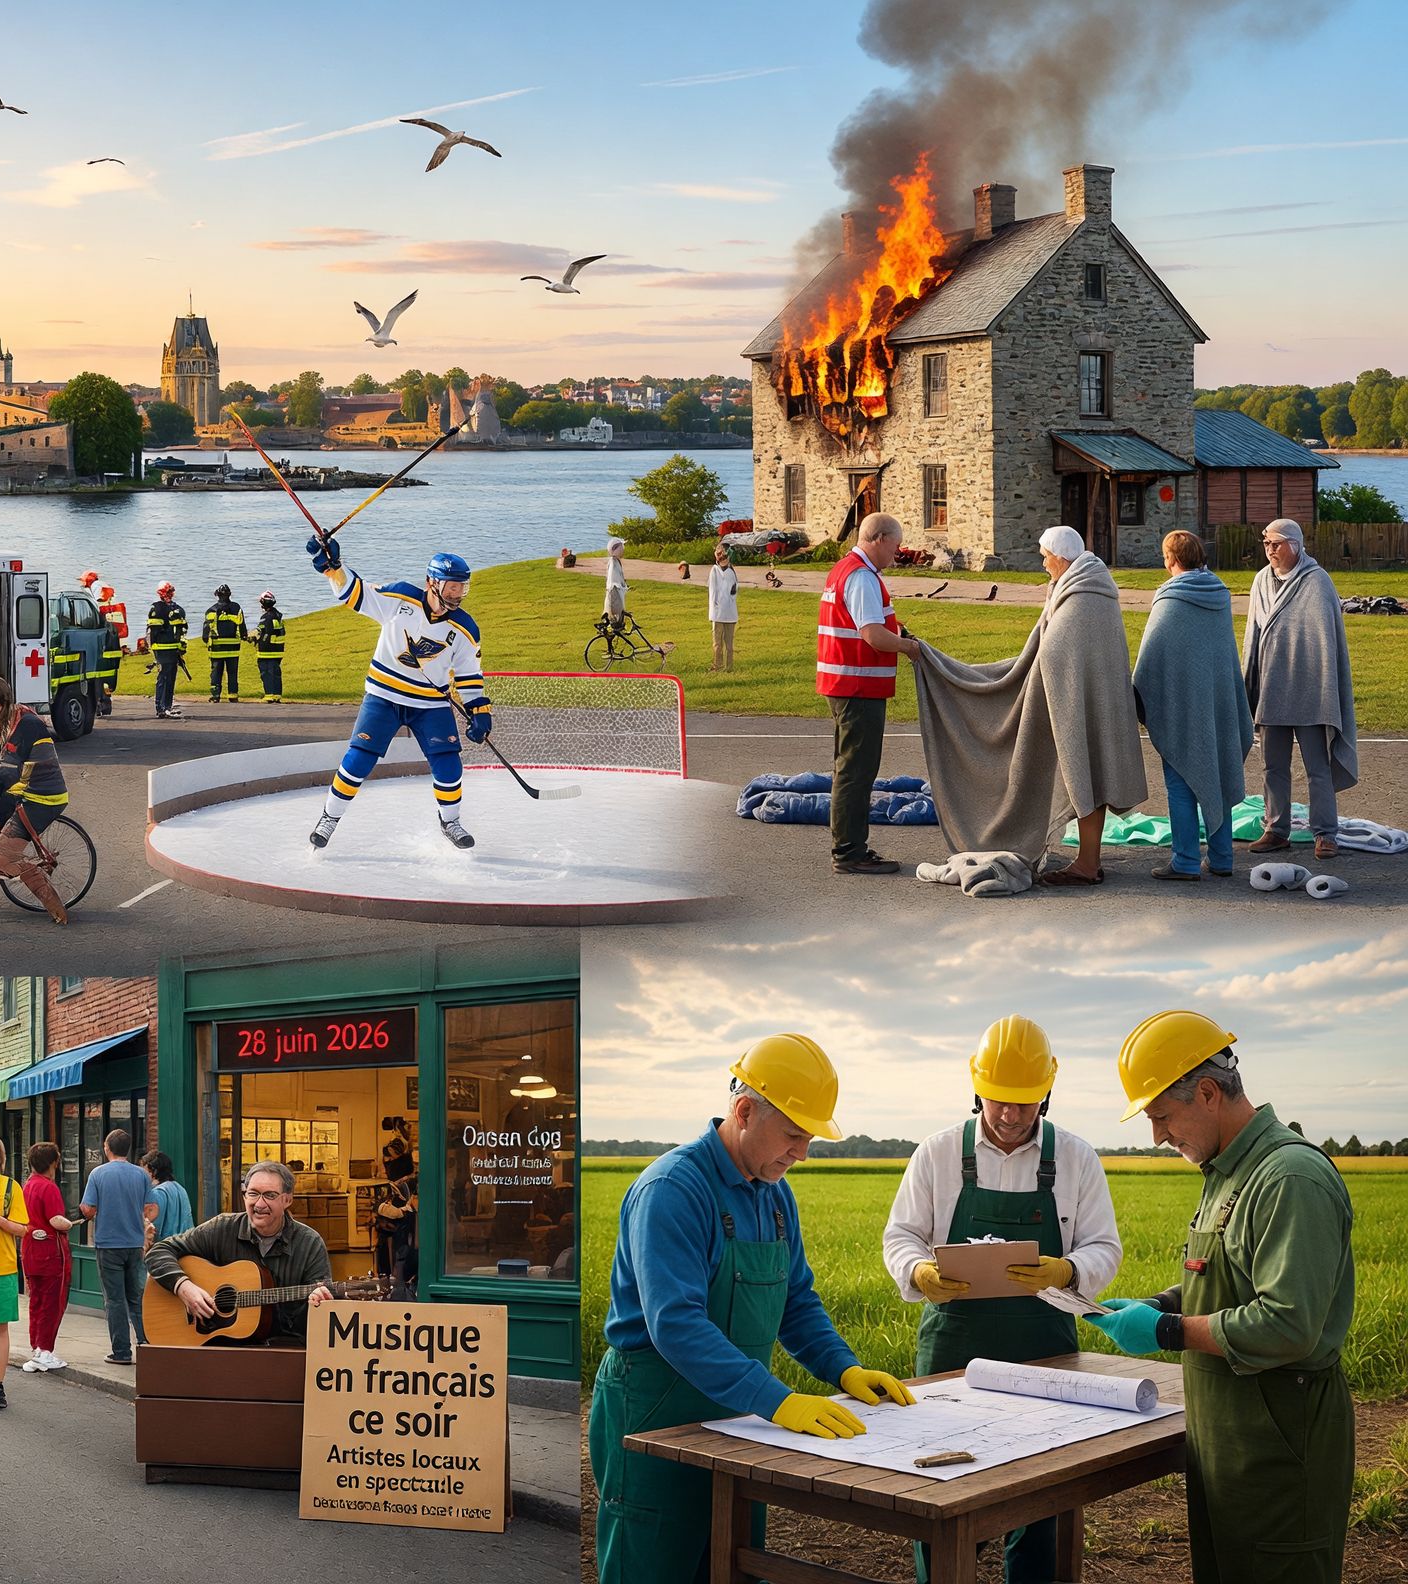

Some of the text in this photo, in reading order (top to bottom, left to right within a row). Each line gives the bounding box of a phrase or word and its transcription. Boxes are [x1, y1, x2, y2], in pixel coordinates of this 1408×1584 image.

[238, 1019, 389, 1062] 28 juin 2026
[328, 1311, 481, 1364] Musique
[315, 1358, 495, 1399] en français
[349, 1401, 457, 1438] ce soir
[326, 1444, 481, 1471] Artistes locaux
[336, 1474, 359, 1490] en
